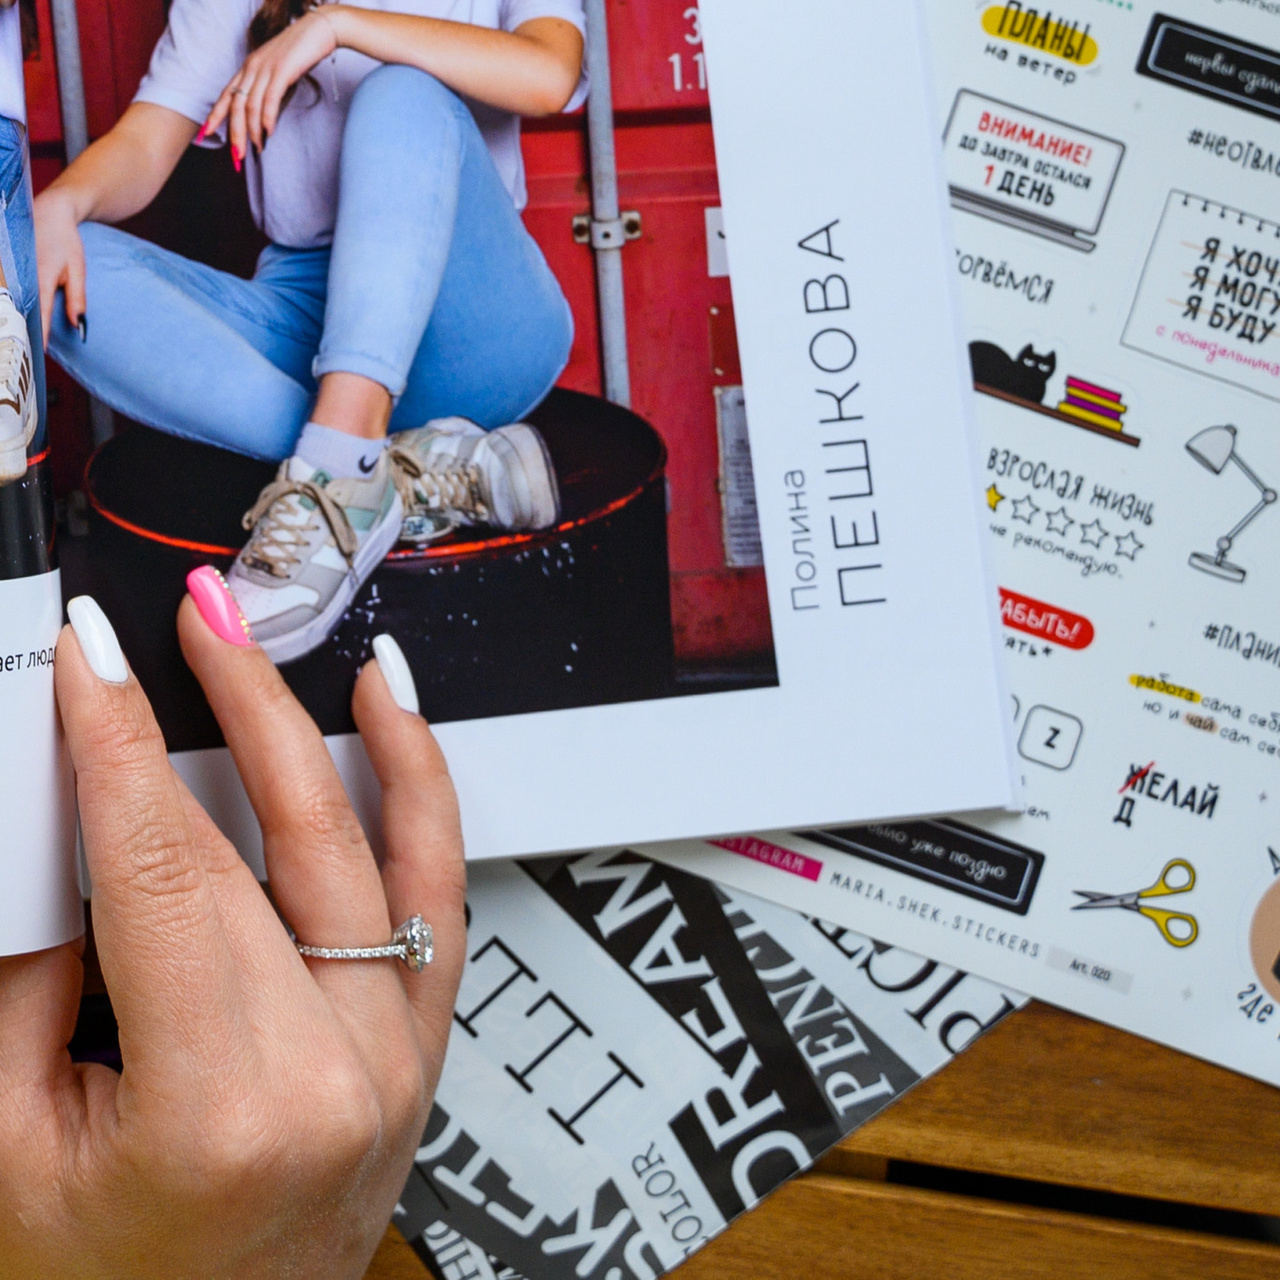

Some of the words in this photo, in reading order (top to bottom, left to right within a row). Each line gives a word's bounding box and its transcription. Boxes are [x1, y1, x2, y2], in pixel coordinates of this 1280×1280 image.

[984, 41, 1009, 63] на
[1016, 54, 1078, 86] ветер
[977, 110, 1094, 167] ВНИМАНИЕ!
[958, 134, 979, 152] ДО
[981, 141, 1030, 170] ЗАВТРА
[1033, 159, 1092, 190] ОСТАЛСЯ
[984, 163, 995, 187] 1
[996, 169, 1056, 207] ДЕНЬ
[1200, 236, 1221, 264] Я
[1189, 265, 1210, 292] Я
[1181, 294, 1203, 321] Я
[1207, 302, 1277, 344] БУДУ
[797, 218, 887, 608] ПЕШКОВА
[1089, 482, 1155, 526] ЖИЗНЬ
[784, 468, 820, 612] Полина
[988, 522, 1008, 538] не
[999, 596, 1083, 642] АБЫТЬ!
[1135, 673, 1196, 703] работа
[1043, 725, 1062, 751] Z
[1184, 712, 1216, 734] чай
